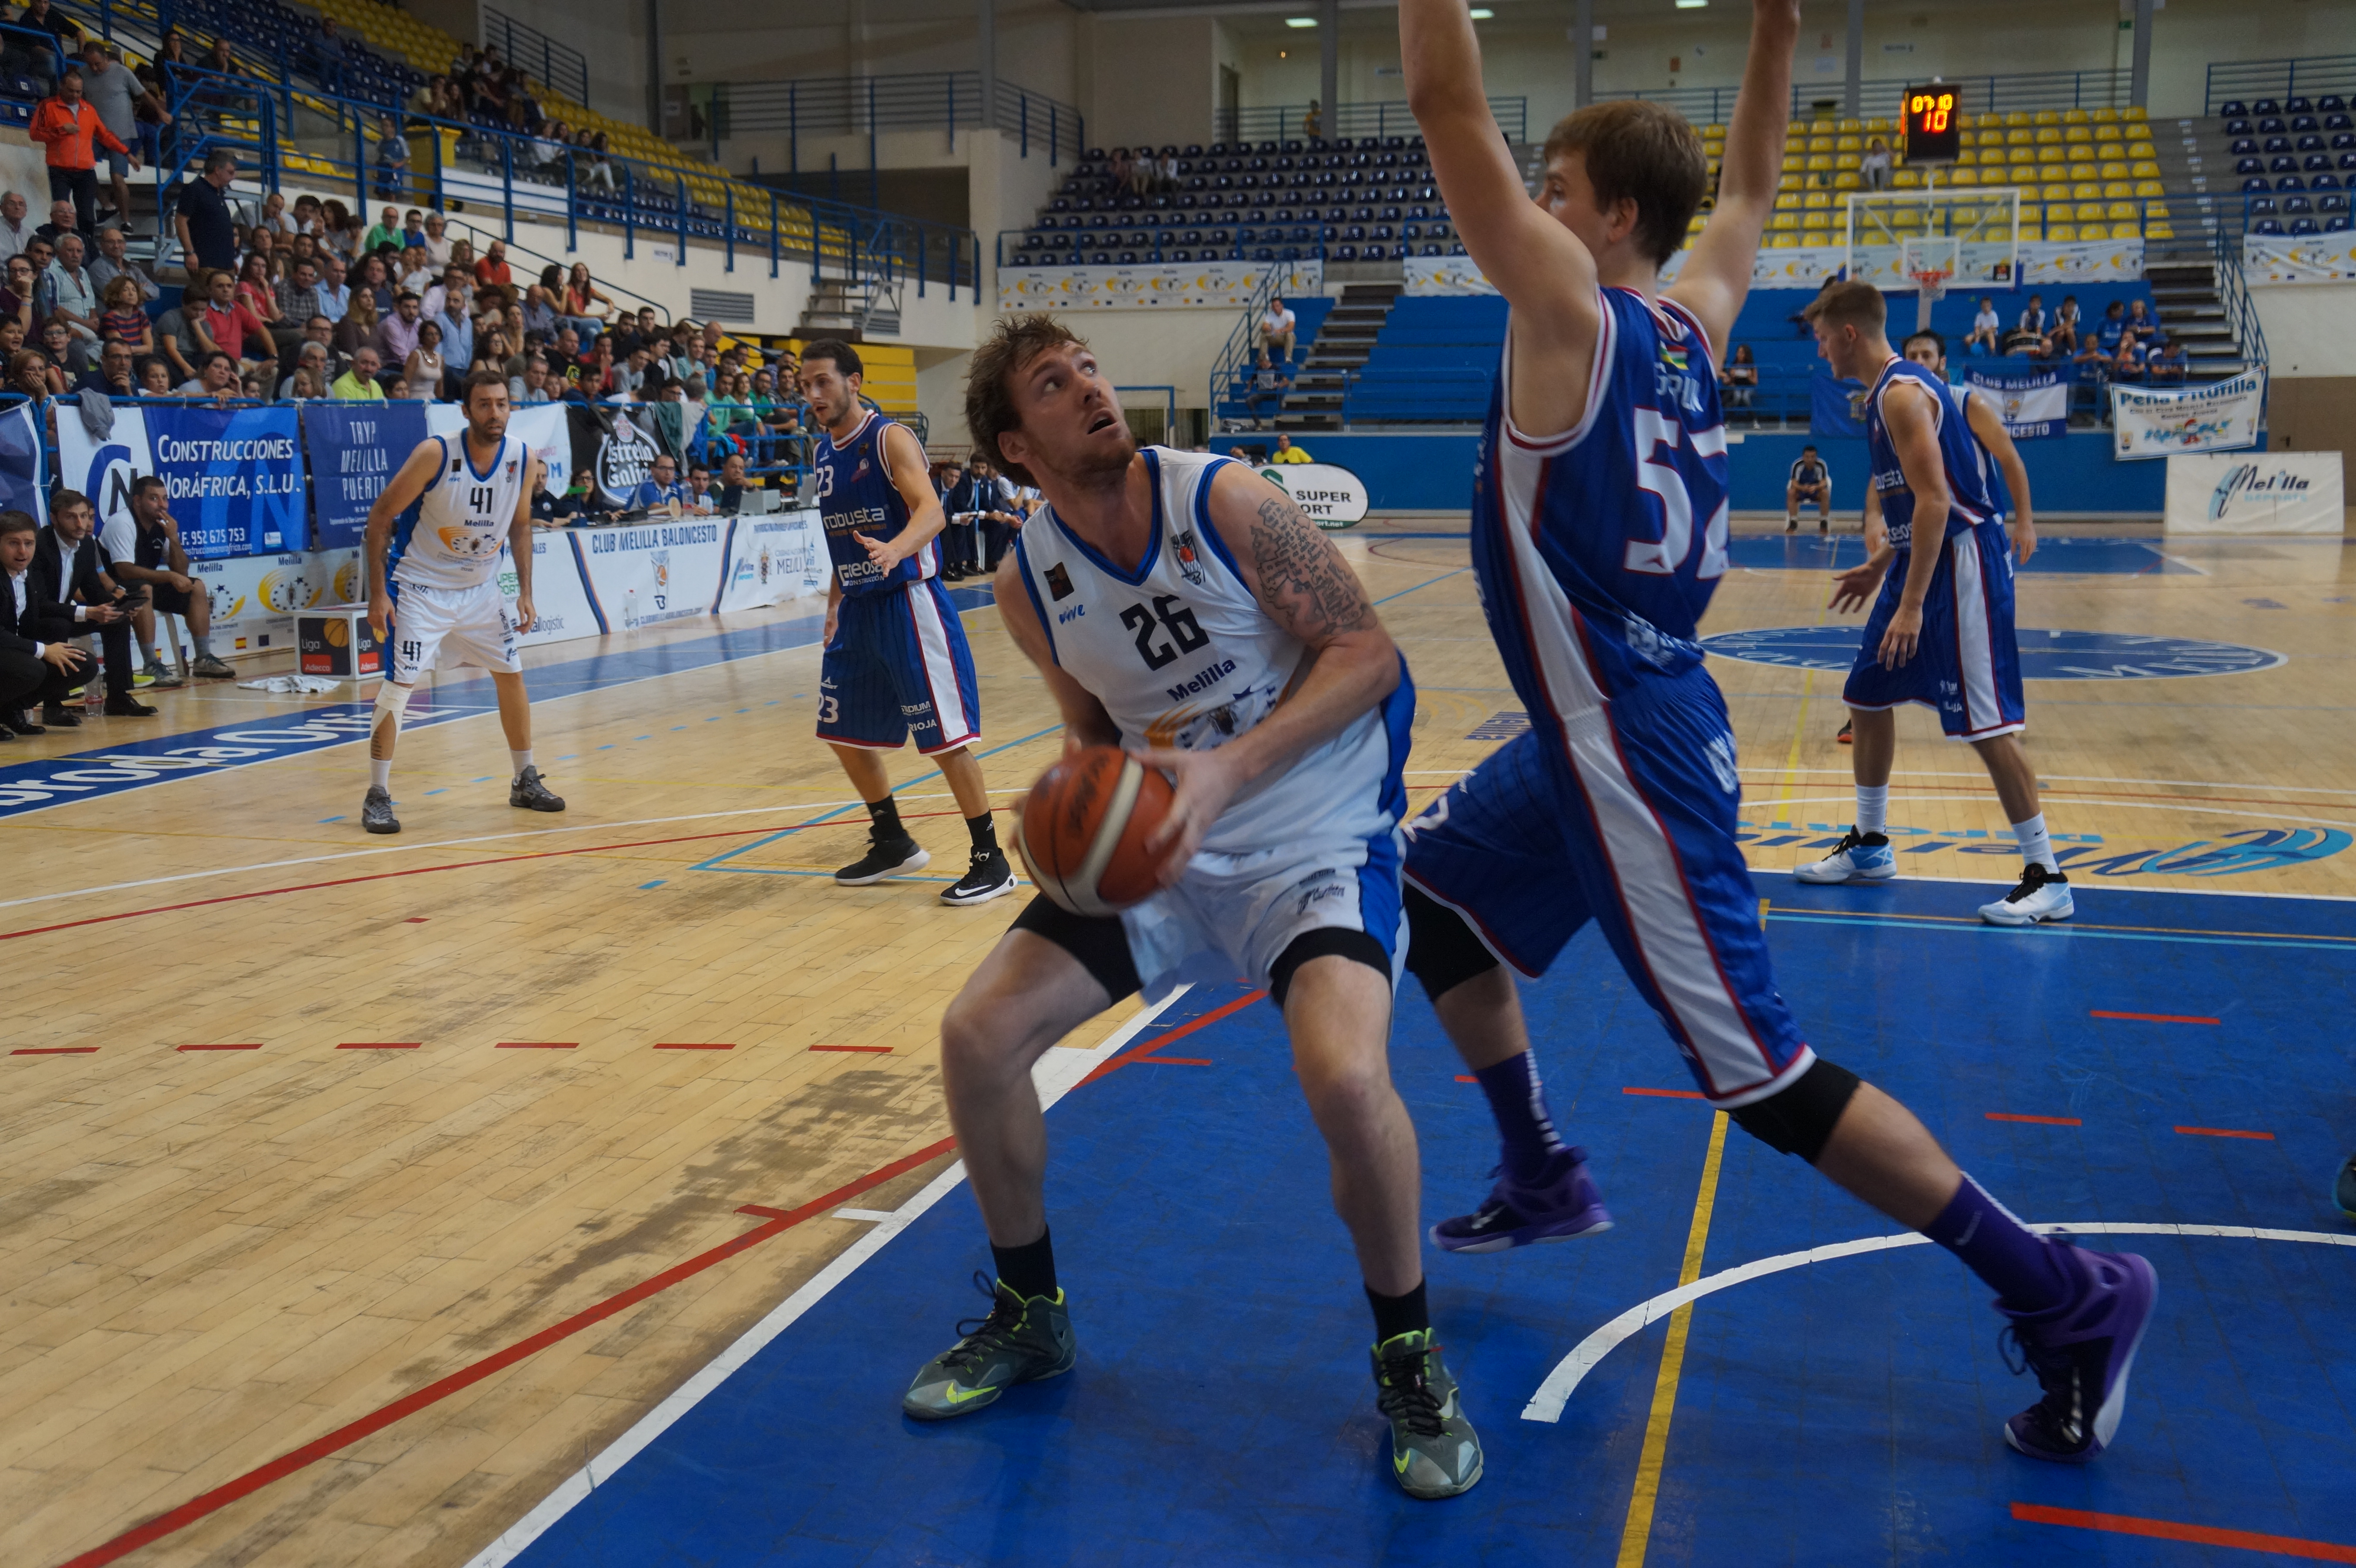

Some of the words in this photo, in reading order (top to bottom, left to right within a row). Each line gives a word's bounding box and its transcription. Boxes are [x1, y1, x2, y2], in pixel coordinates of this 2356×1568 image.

[1924, 110, 1948, 132] 10
[1973, 371, 2001, 389] CLUB
[2006, 371, 2056, 389] MELILLA
[350, 420, 377, 444] TRYP
[2004, 421, 2050, 438] NCESTO
[158, 434, 294, 463] CONSTRUCCIONES
[341, 448, 388, 473] MELILLA
[256, 474, 301, 494] S.L.U.
[342, 475, 387, 501] PUERTO
[817, 465, 834, 498] 23
[469, 488, 493, 513] 41
[1296, 490, 1351, 503] SUPER
[823, 507, 885, 529] robusta
[1300, 504, 1333, 515] ORT
[191, 530, 208, 545] 952
[209, 529, 227, 544] 675
[228, 528, 245, 541] 753
[592, 533, 615, 554] CLUB
[619, 529, 659, 551] MELILLA
[662, 525, 717, 547] BALONCESTO
[197, 563, 223, 573] Melilla
[279, 555, 301, 566] Melilla
[1058, 604, 1085, 625] vive
[1119, 594, 1210, 672] 26
[301, 639, 320, 651] Liga
[358, 638, 371, 651] Liga
[402, 641, 421, 662] 41
[361, 663, 378, 671] Adecco
[1166, 659, 1236, 702] Melilla
[817, 691, 838, 723] 23
[908, 719, 937, 731] RIOJA
